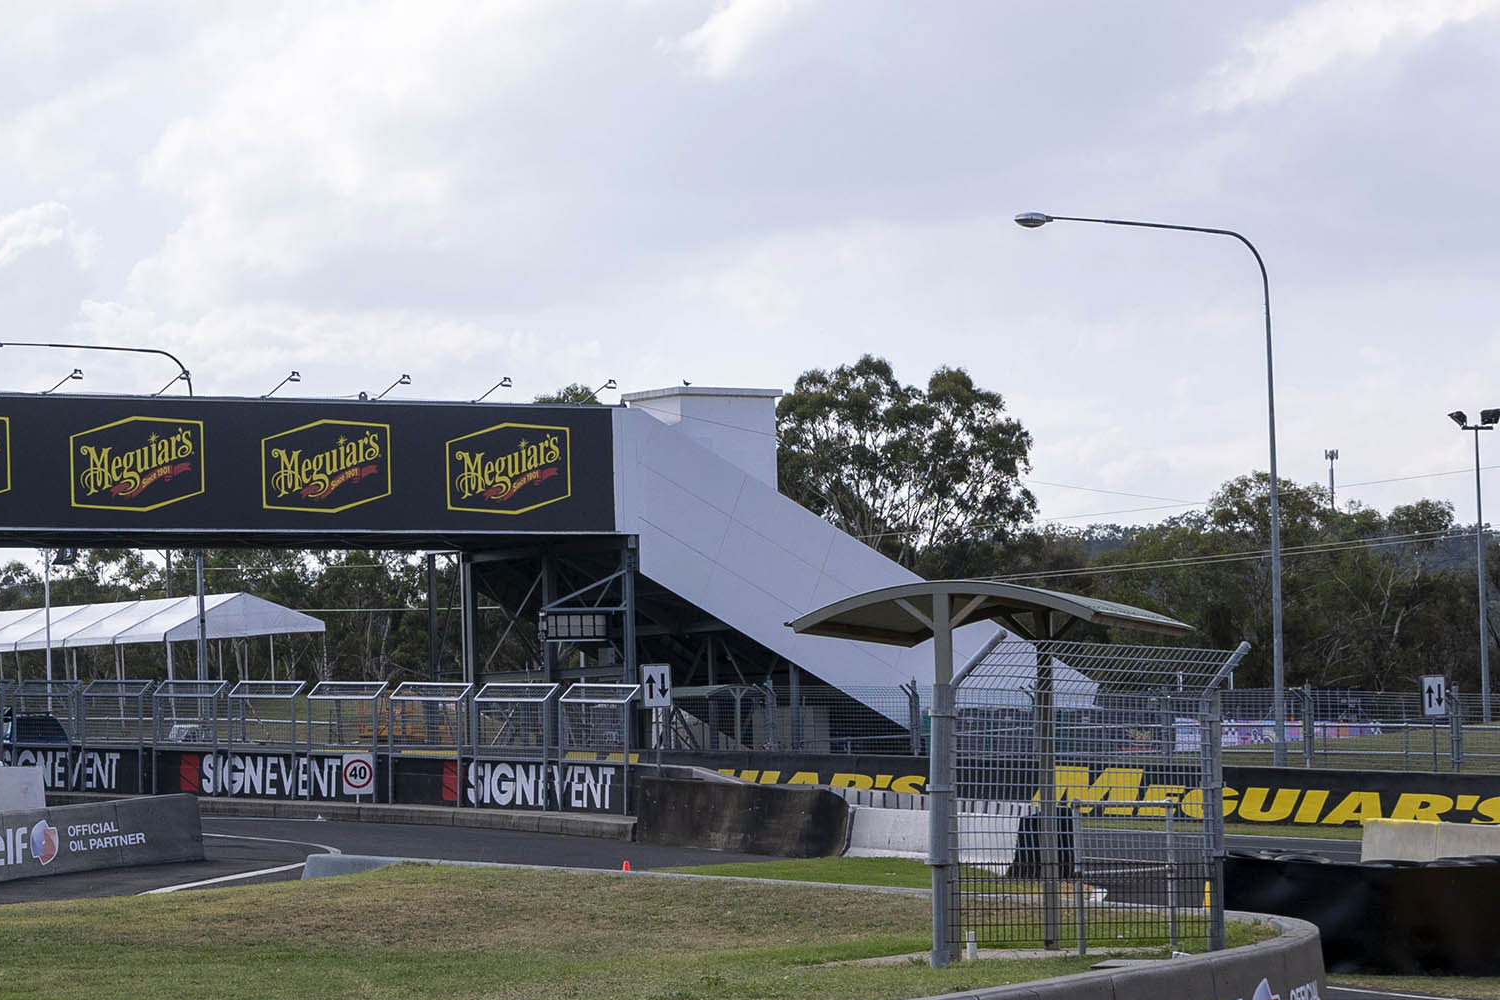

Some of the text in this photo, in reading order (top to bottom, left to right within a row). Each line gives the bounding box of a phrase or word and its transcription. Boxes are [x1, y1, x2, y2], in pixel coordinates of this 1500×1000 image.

[80, 427, 193, 496] Meguiar's
[271, 430, 380, 498] Meguiar's
[455, 434, 560, 499] Meguiar's
[349, 766, 367, 780] 40
[67, 821, 119, 838] OFFICIAL
[69, 832, 146, 853] OIL PARTNER
